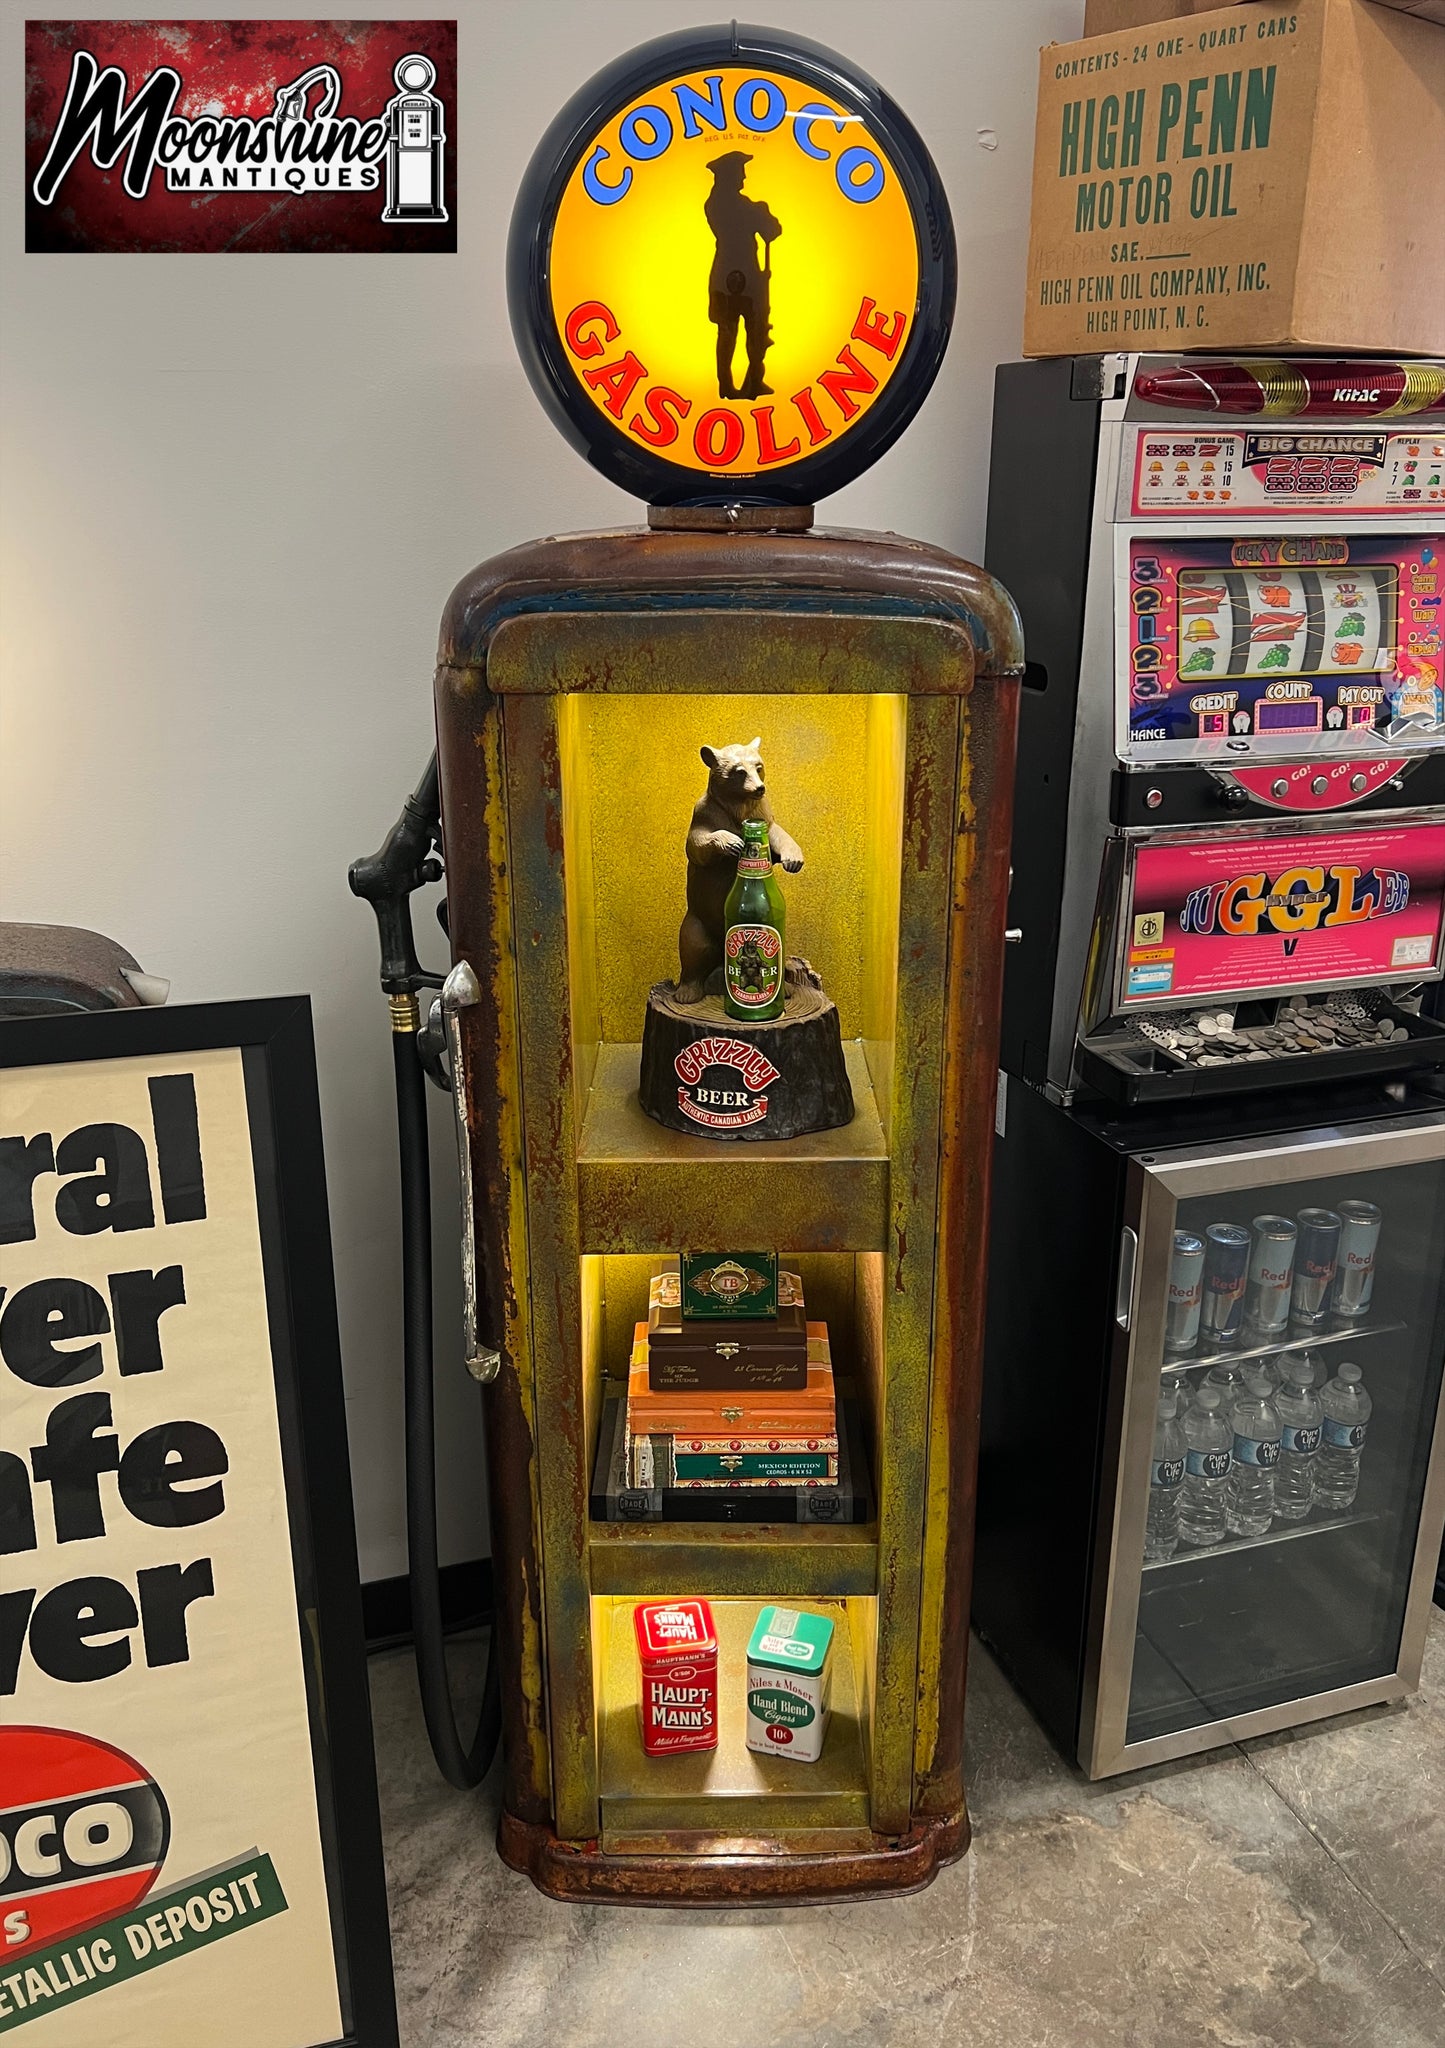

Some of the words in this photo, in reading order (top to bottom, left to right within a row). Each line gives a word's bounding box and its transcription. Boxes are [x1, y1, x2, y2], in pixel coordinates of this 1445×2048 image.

[1055, 51, 1120, 80] CONTENTS
[1133, 45, 1148, 63] 24
[1199, 24, 1248, 53] QUART
[1257, 15, 1298, 39] CANS
[1059, 88, 1146, 178] HIGH
[1156, 64, 1278, 163] PENN
[583, 76, 885, 205] CONOCO
[1075, 172, 1173, 233] MOTOR
[1190, 163, 1237, 219] OIL
[1041, 279, 1072, 306] HIGH
[1077, 275, 1114, 303] PENN
[1120, 272, 1143, 300] OIL
[1150, 265, 1231, 298] COMPANY,
[1237, 262, 1271, 292] INC.
[1087, 308, 1118, 334] HIGH
[1124, 307, 1170, 333] POINT,
[564, 296, 907, 466] GASOLINE
[1225, 445, 1235, 456] 15
[1257, 437, 1295, 452] BIG
[1296, 437, 1375, 452] CHANCE
[1224, 461, 1233, 472] 15
[1393, 461, 1399, 472] 2
[1222, 475, 1231, 486] 10
[1391, 475, 1397, 485] 7
[1133, 558, 1161, 584] 3
[1133, 587, 1161, 614] 2
[1413, 609, 1436, 621] WAIT
[1408, 643, 1437, 656] REPLAY
[1133, 645, 1161, 671] 2
[1133, 673, 1160, 699] 3
[1266, 681, 1312, 700] COUNT
[1191, 691, 1238, 712] CREDIT
[1338, 686, 1361, 705] PAY
[1362, 686, 1384, 704] OUT
[1213, 715, 1222, 731] 5
[1291, 764, 1311, 780] GO!
[1331, 762, 1351, 778] GO!
[1370, 760, 1390, 775] GO!
[1180, 866, 1410, 935] JUGGLER
[726, 929, 780, 958] GRIZZLY
[1282, 938, 1298, 956] V
[674, 1037, 781, 1092] GRIZZLY
[697, 1088, 749, 1106] BEER
[681, 1101, 711, 1122] AUTHENTIC
[710, 1115, 742, 1125] CANADIAN
[743, 1108, 763, 1122] LAGER
[1347, 1252, 1372, 1264] Red
[1261, 1268, 1286, 1280] Red
[1306, 1260, 1332, 1273] Red
[1211, 1275, 1238, 1289] Red
[1169, 1284, 1194, 1297] Red
[0, 1264, 187, 1387] er
[1301, 1429, 1319, 1437] Pure
[1262, 1442, 1280, 1451] Pure
[1302, 1436, 1316, 1448] Life
[1209, 1453, 1228, 1462] Pure
[1264, 1448, 1278, 1459] Life
[1164, 1460, 1182, 1470] Pure
[1211, 1460, 1226, 1471] Life
[1166, 1468, 1180, 1479] Life
[620, 1497, 643, 1510] GRADE
[811, 1498, 833, 1510] GRADE
[656, 1653, 706, 1665] HAUPTMANN'S
[651, 1682, 713, 1706] HAUPT-
[750, 1677, 773, 1689] Niles
[775, 1680, 781, 1688] &
[783, 1679, 814, 1701] Moser
[753, 1694, 777, 1710] Hand
[781, 1700, 808, 1717] Blend
[652, 1705, 713, 1729] MANN'S
[764, 1709, 796, 1724] Cigars
[654, 1737, 673, 1746] Mild
[679, 1732, 713, 1744] Fragrant
[0, 1802, 134, 1884] CO
[124, 1871, 263, 1961] DEPOSIT
